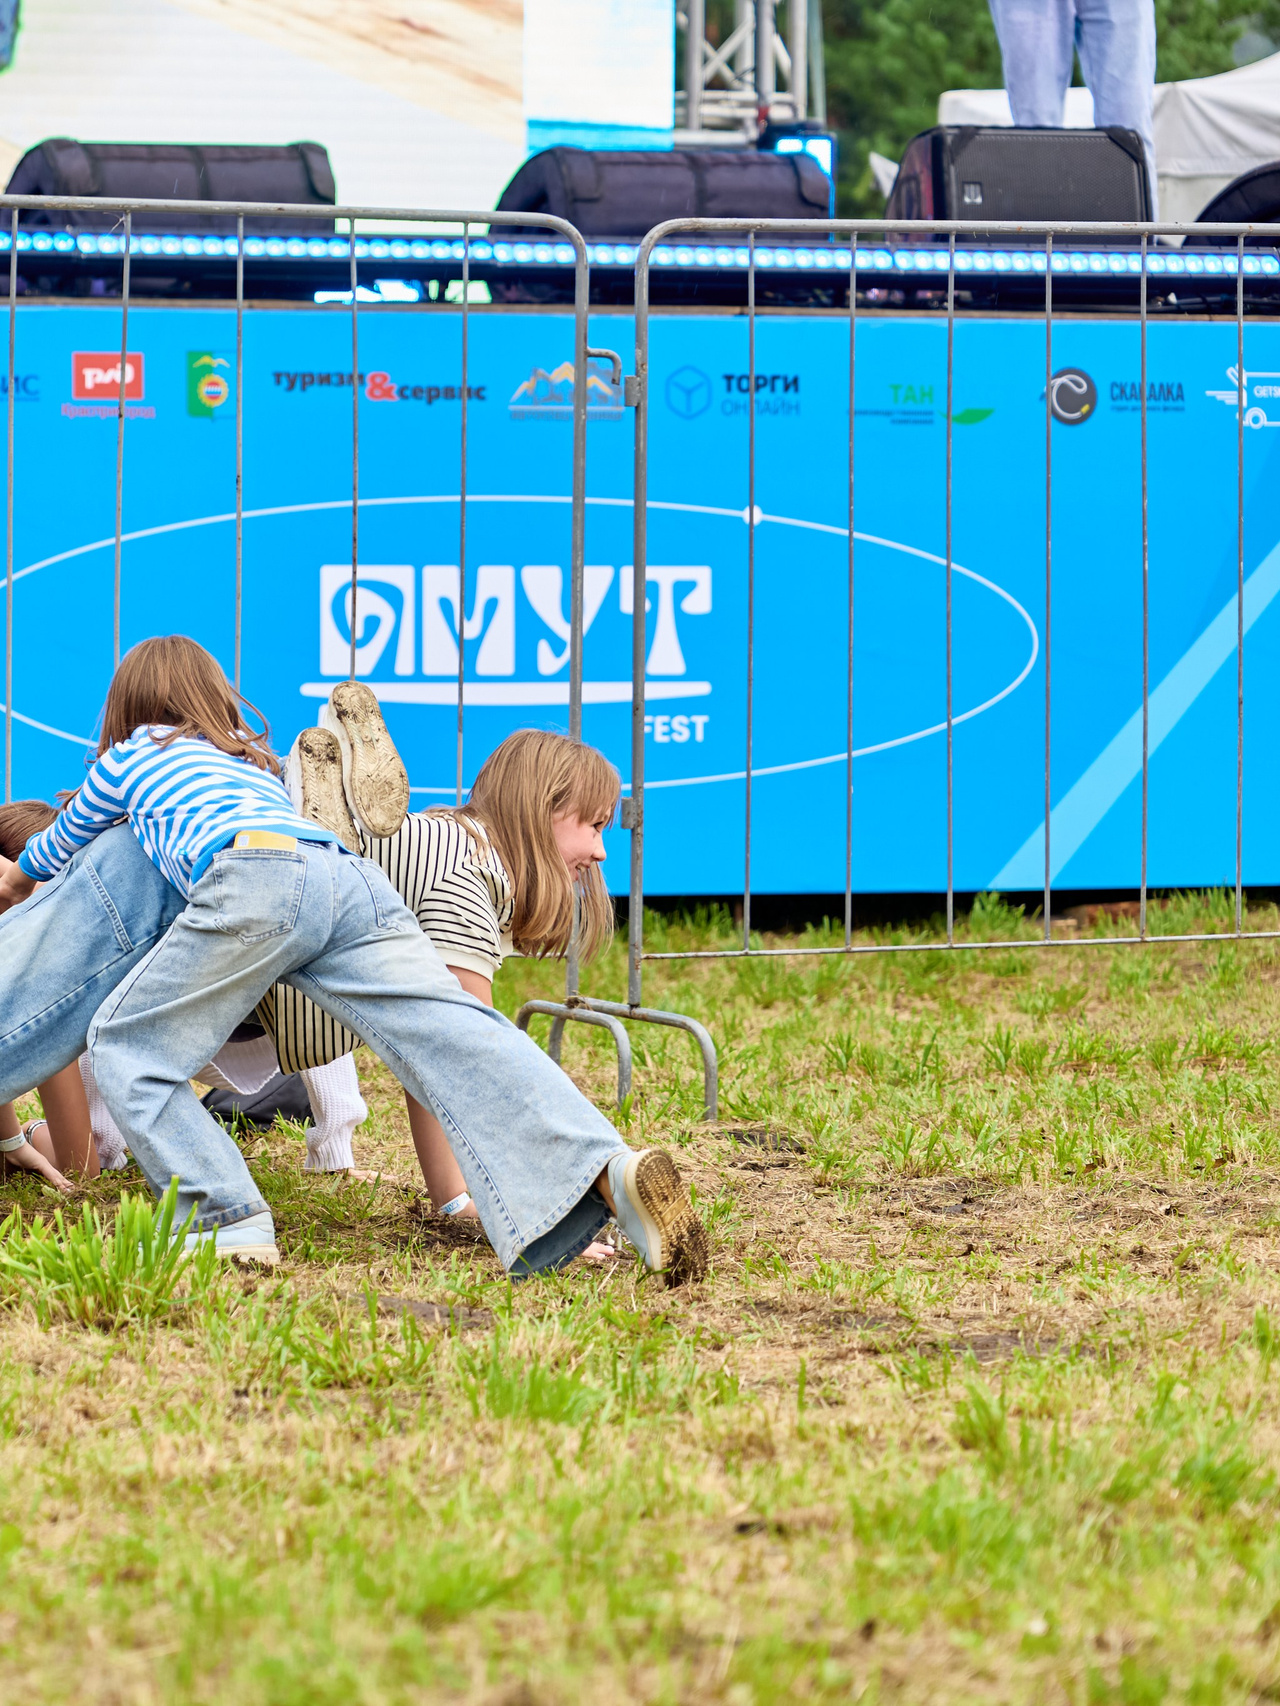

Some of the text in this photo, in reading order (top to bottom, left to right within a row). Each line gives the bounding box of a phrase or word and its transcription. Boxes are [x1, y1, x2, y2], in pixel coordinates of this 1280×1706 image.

[722, 374, 800, 394] ТОРГИ
[1253, 385, 1280, 398] GETS
[889, 384, 935, 404] ТАН
[61, 403, 156, 419] Красприород
